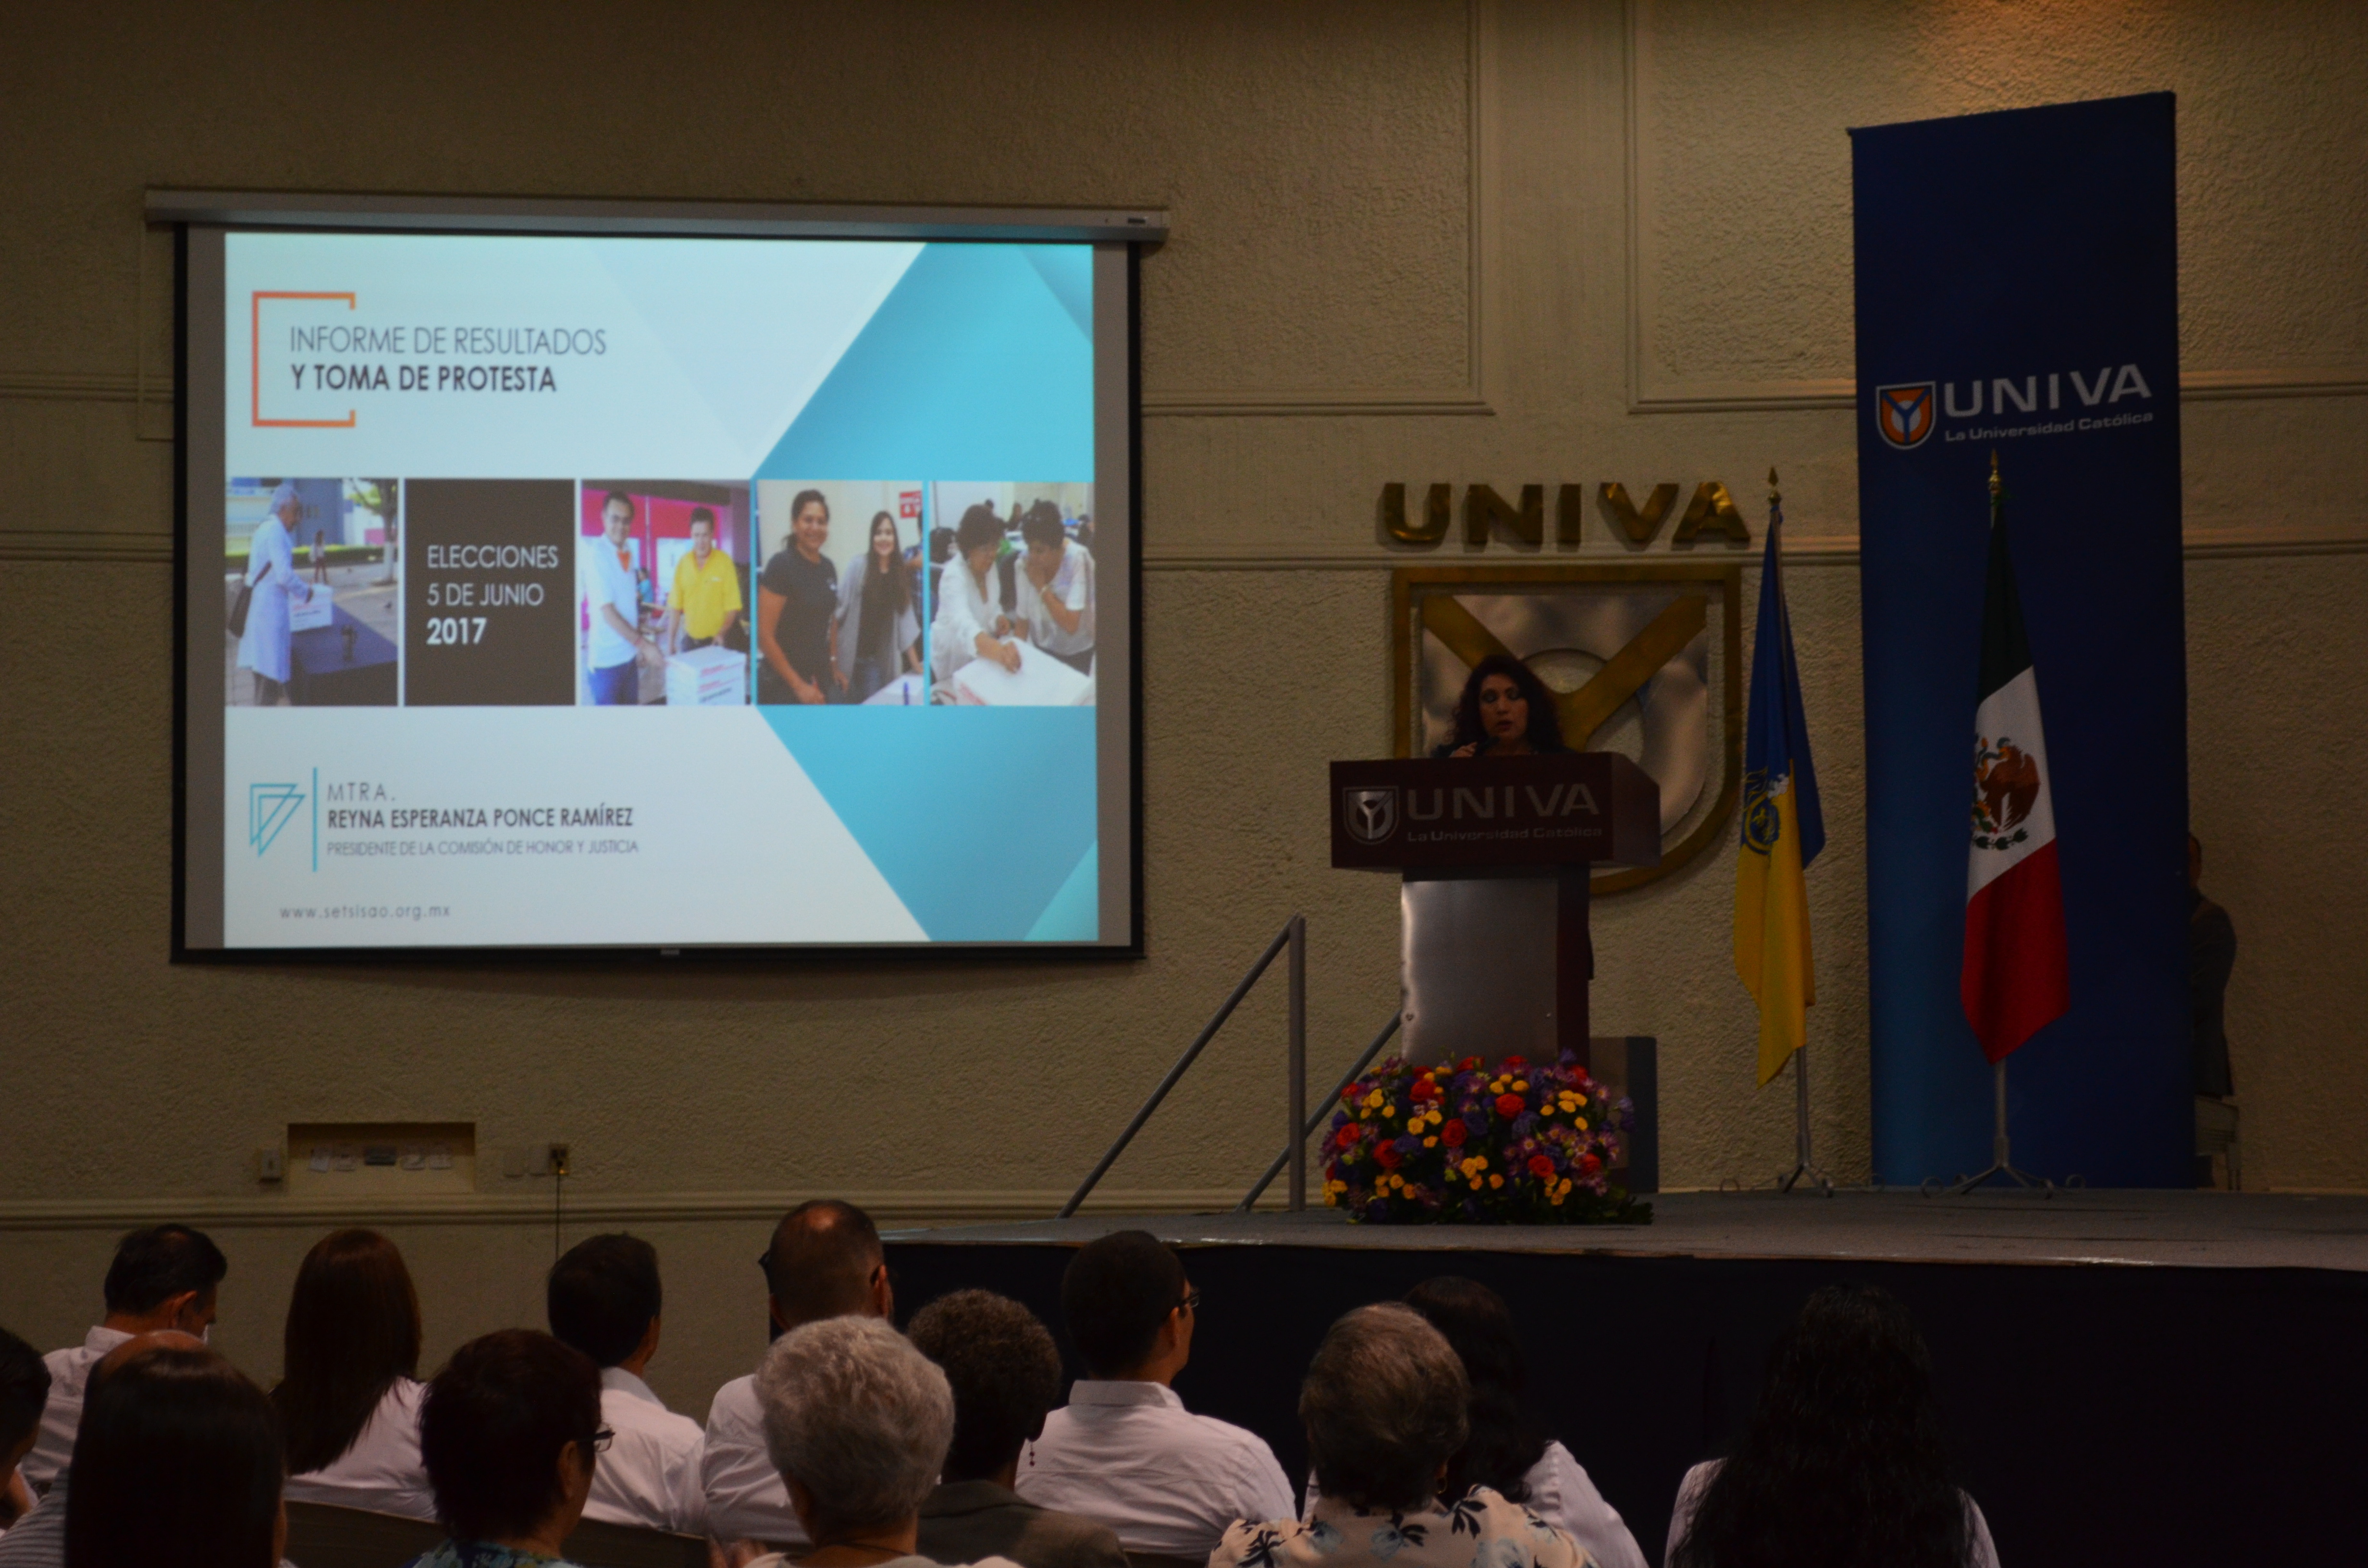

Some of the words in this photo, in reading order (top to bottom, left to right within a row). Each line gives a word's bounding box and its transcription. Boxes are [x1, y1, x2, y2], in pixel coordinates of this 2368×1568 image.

[290, 326, 405, 354] INFORME
[414, 327, 446, 354] DE
[454, 328, 607, 355] RESULTADOS
[291, 365, 305, 390] Y
[314, 365, 390, 391] TOMA
[400, 365, 429, 391] DE
[438, 366, 556, 392] PROTESTA
[1943, 363, 2153, 418] UNIVA
[1945, 429, 1966, 442] La
[1969, 419, 2074, 440] Universidad
[2078, 411, 2154, 431] Católica
[1384, 482, 1751, 544] UNIVA
[427, 544, 559, 569] ELECCIONES
[426, 582, 440, 607] 5
[445, 582, 474, 606] DE
[480, 582, 544, 607] JUNIO
[426, 617, 487, 645] 2017
[327, 782, 396, 802] MTRA.
[1407, 783, 1601, 821] UNIVA
[328, 809, 385, 829] REYNA
[391, 808, 487, 829] ESPERANZA
[493, 808, 555, 827] PONCE
[560, 802, 633, 827] RAMÍREZ
[327, 841, 396, 856] PRESIDENTE
[399, 841, 418, 855] DE
[419, 841, 435, 855] LA
[438, 837, 504, 855] COMISIÓN
[506, 840, 523, 855] DE
[526, 840, 573, 854] HONOR
[577, 840, 584, 854] Y
[588, 840, 639, 854] JUSTICIA
[1408, 832, 1427, 842] La
[1430, 828, 1529, 842] Universidad
[1532, 826, 1603, 839] Católica
